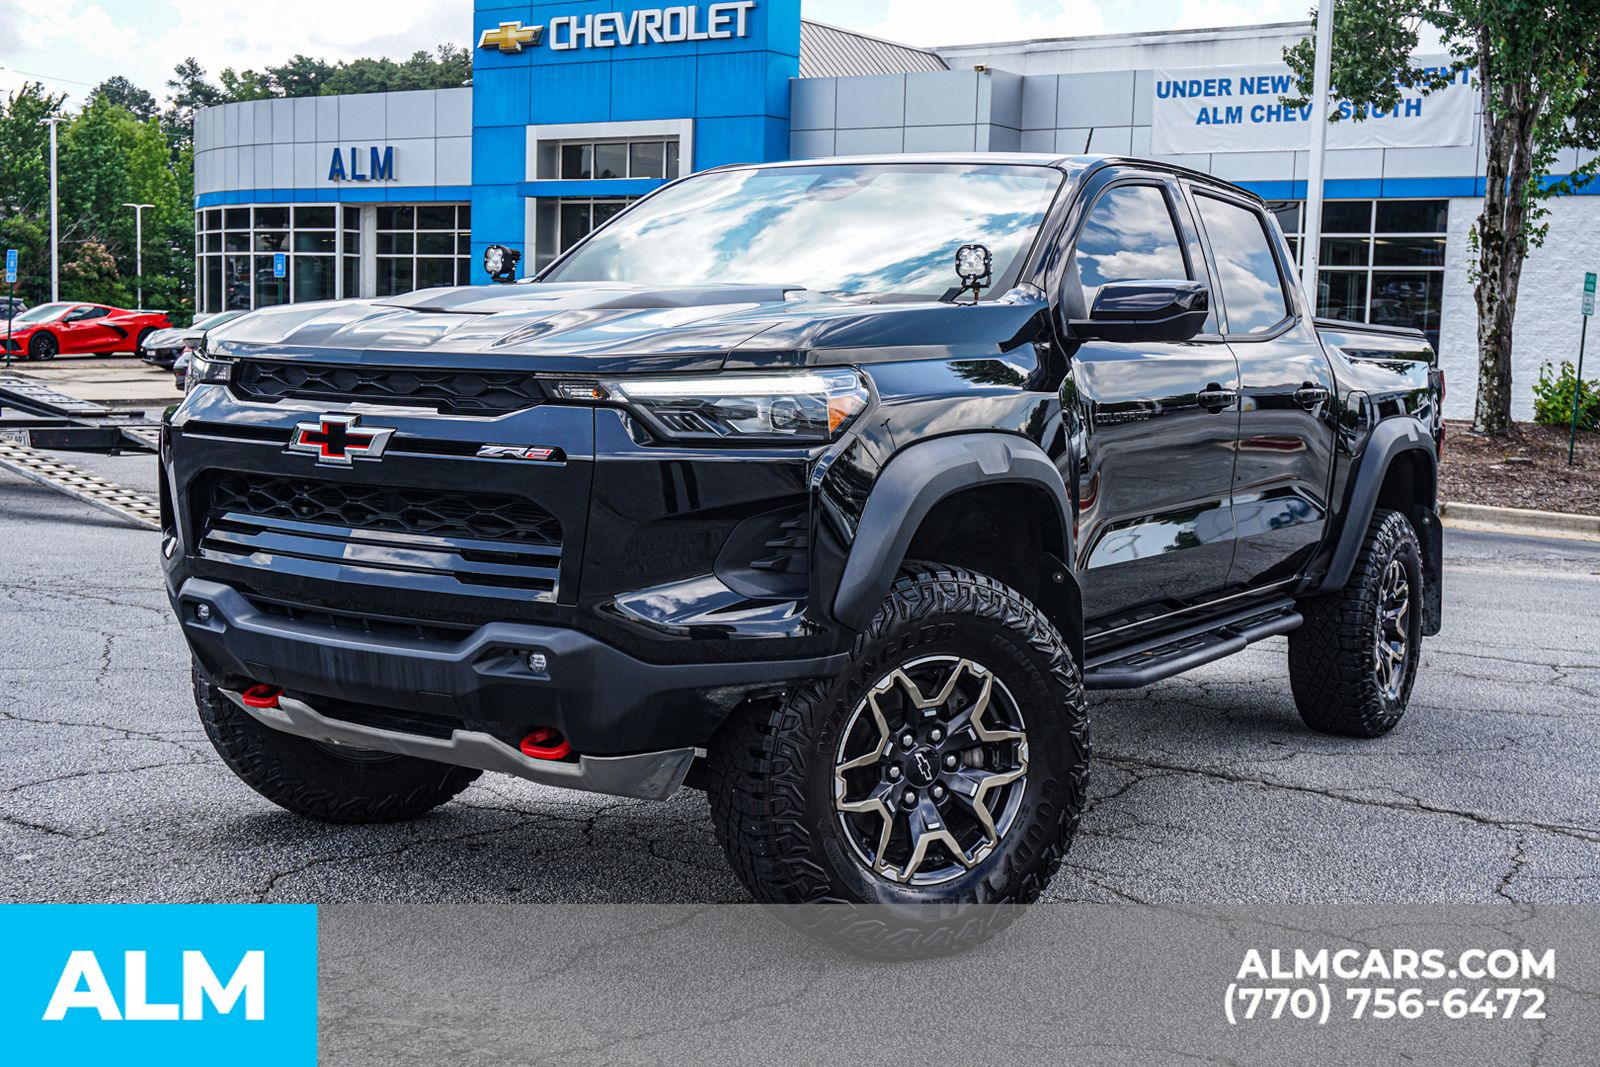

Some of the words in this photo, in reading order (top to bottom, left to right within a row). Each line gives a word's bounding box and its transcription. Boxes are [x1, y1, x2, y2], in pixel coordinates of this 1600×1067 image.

[549, 0, 756, 50] CHEVROLET
[1156, 78, 1232, 99] UNDER
[1239, 75, 1291, 96] NEW
[1195, 106, 1243, 125] ALM
[1250, 102, 1328, 124] CHEV
[328, 146, 395, 181] ALM
[1095, 410, 1149, 423] COLORADO
[476, 445, 554, 460] ZR2
